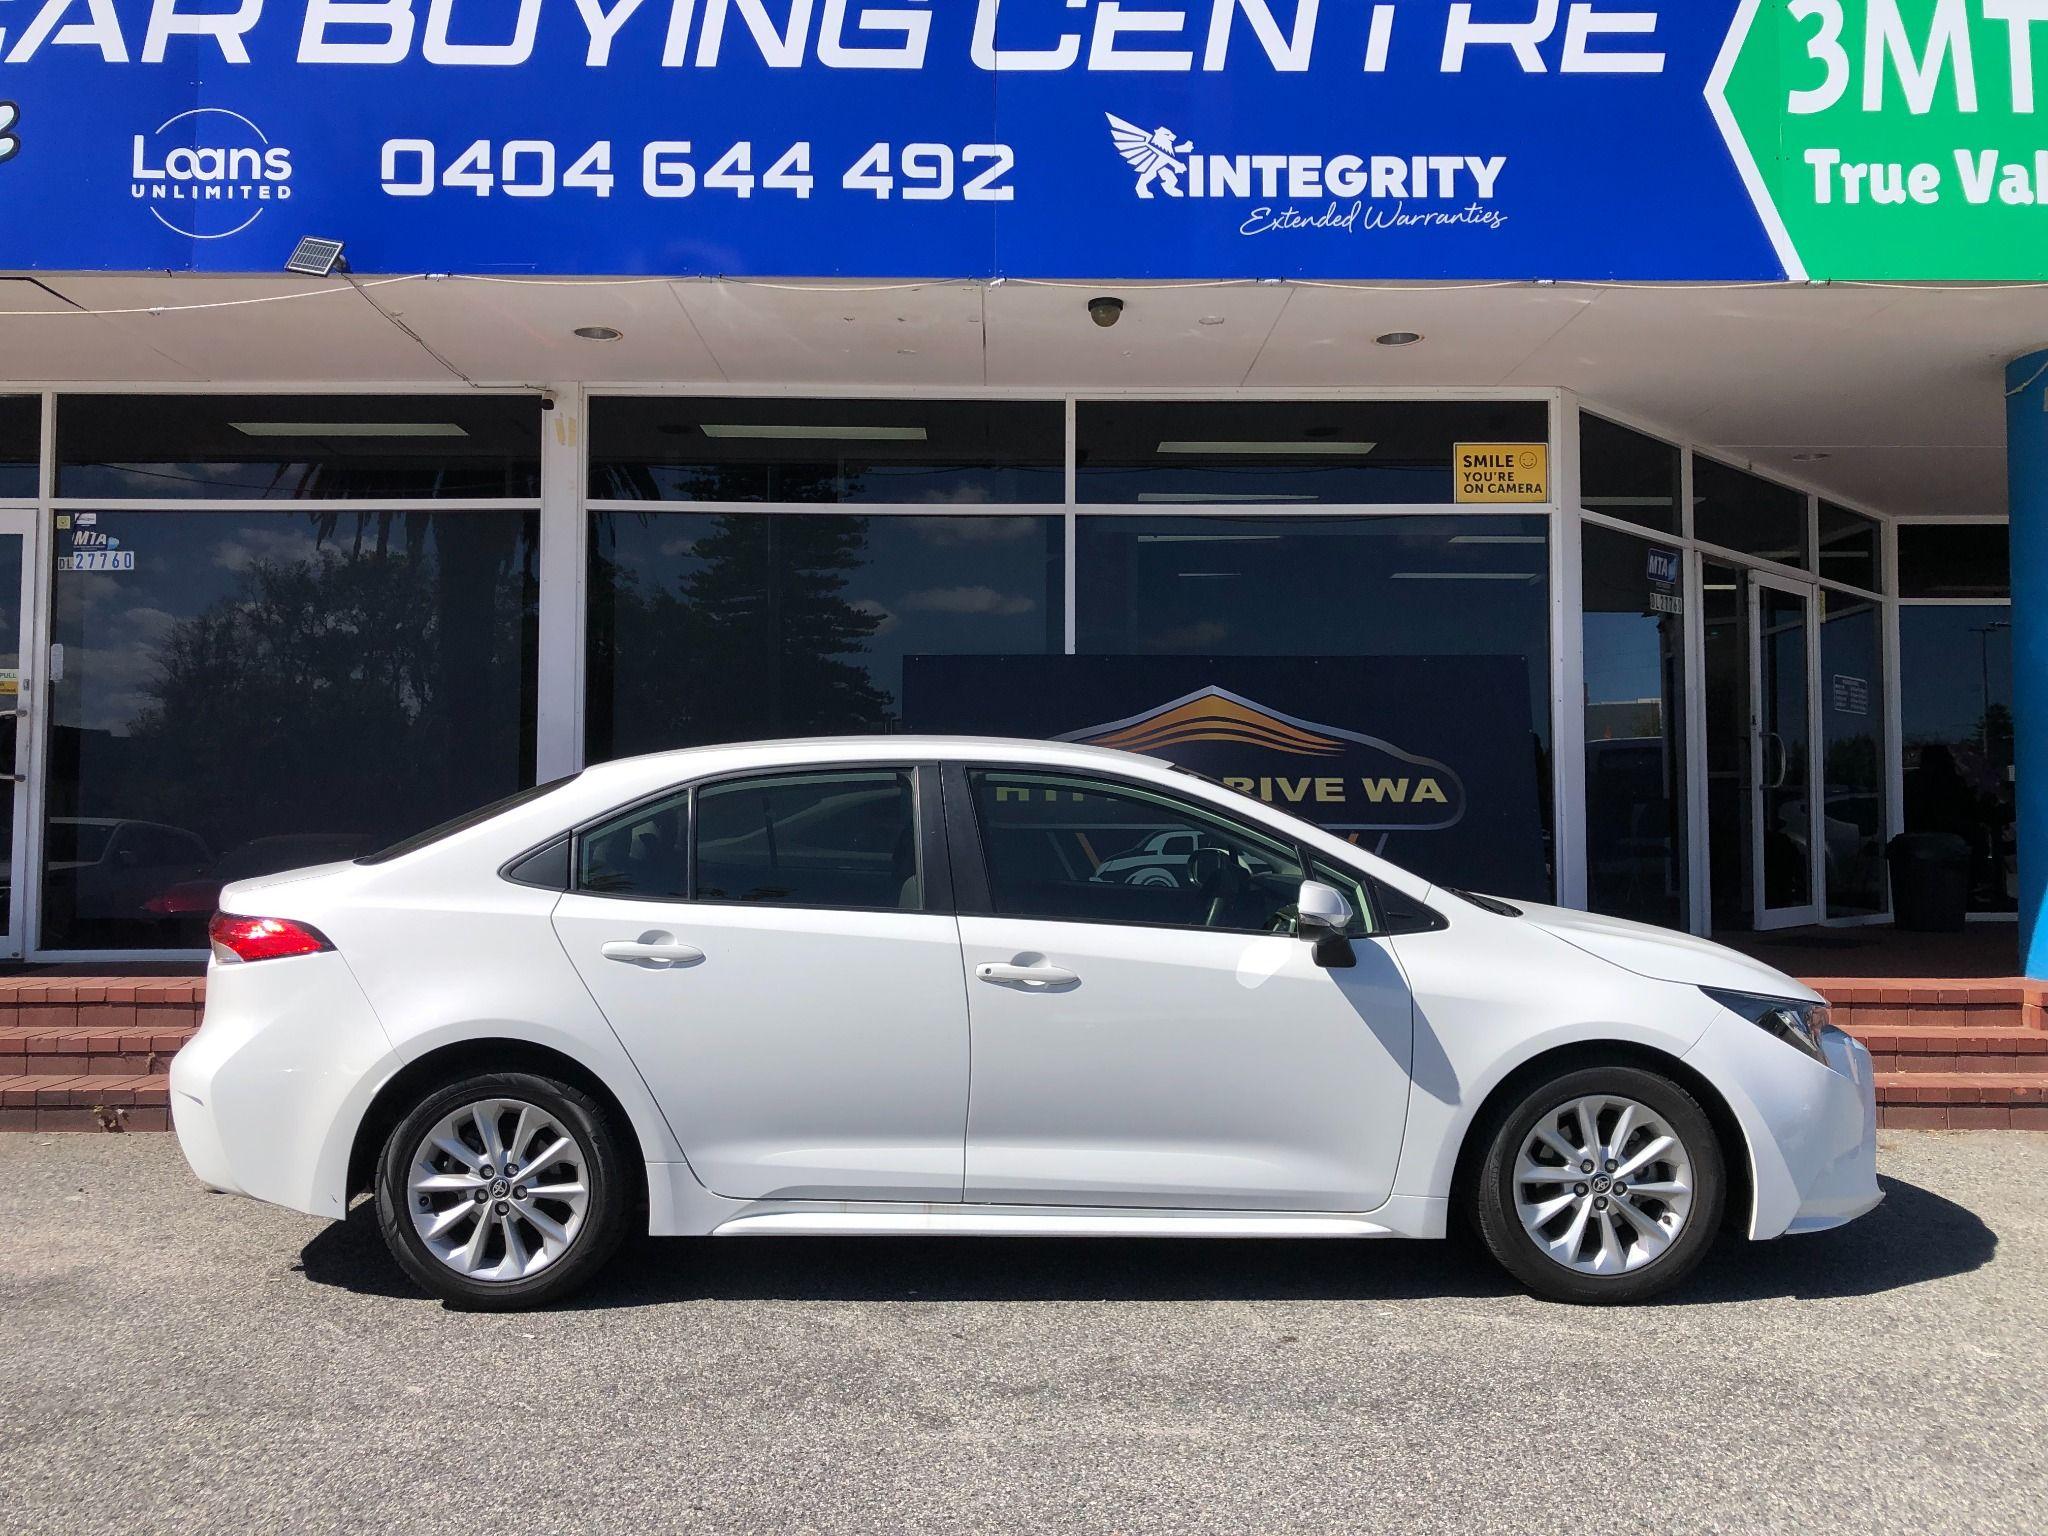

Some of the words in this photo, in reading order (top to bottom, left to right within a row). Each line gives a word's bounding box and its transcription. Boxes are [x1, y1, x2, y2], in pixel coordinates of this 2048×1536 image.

[0, 0, 263, 63] AR
[297, 0, 932, 68] BUYING
[133, 135, 292, 181] Loans
[382, 139, 613, 197] 0404
[643, 142, 813, 198] 644
[843, 143, 1013, 200] 492
[1190, 155, 1506, 197] INTEGRITY
[1804, 149, 1940, 204] True
[1954, 149, 2048, 204] Val
[132, 185, 290, 199] UNLIMITED
[1239, 200, 1360, 236] Extended
[1364, 201, 1508, 230] Warranties
[1463, 454, 1515, 468] SMILE
[1463, 471, 1515, 482] YOU'RE
[1463, 483, 1484, 493] ON
[1488, 483, 1542, 493] CAMERA
[73, 530, 107, 546] MTA
[1648, 555, 1668, 577] MTA
[1223, 775, 1347, 803] RIVE
[1361, 777, 1448, 803] WA
